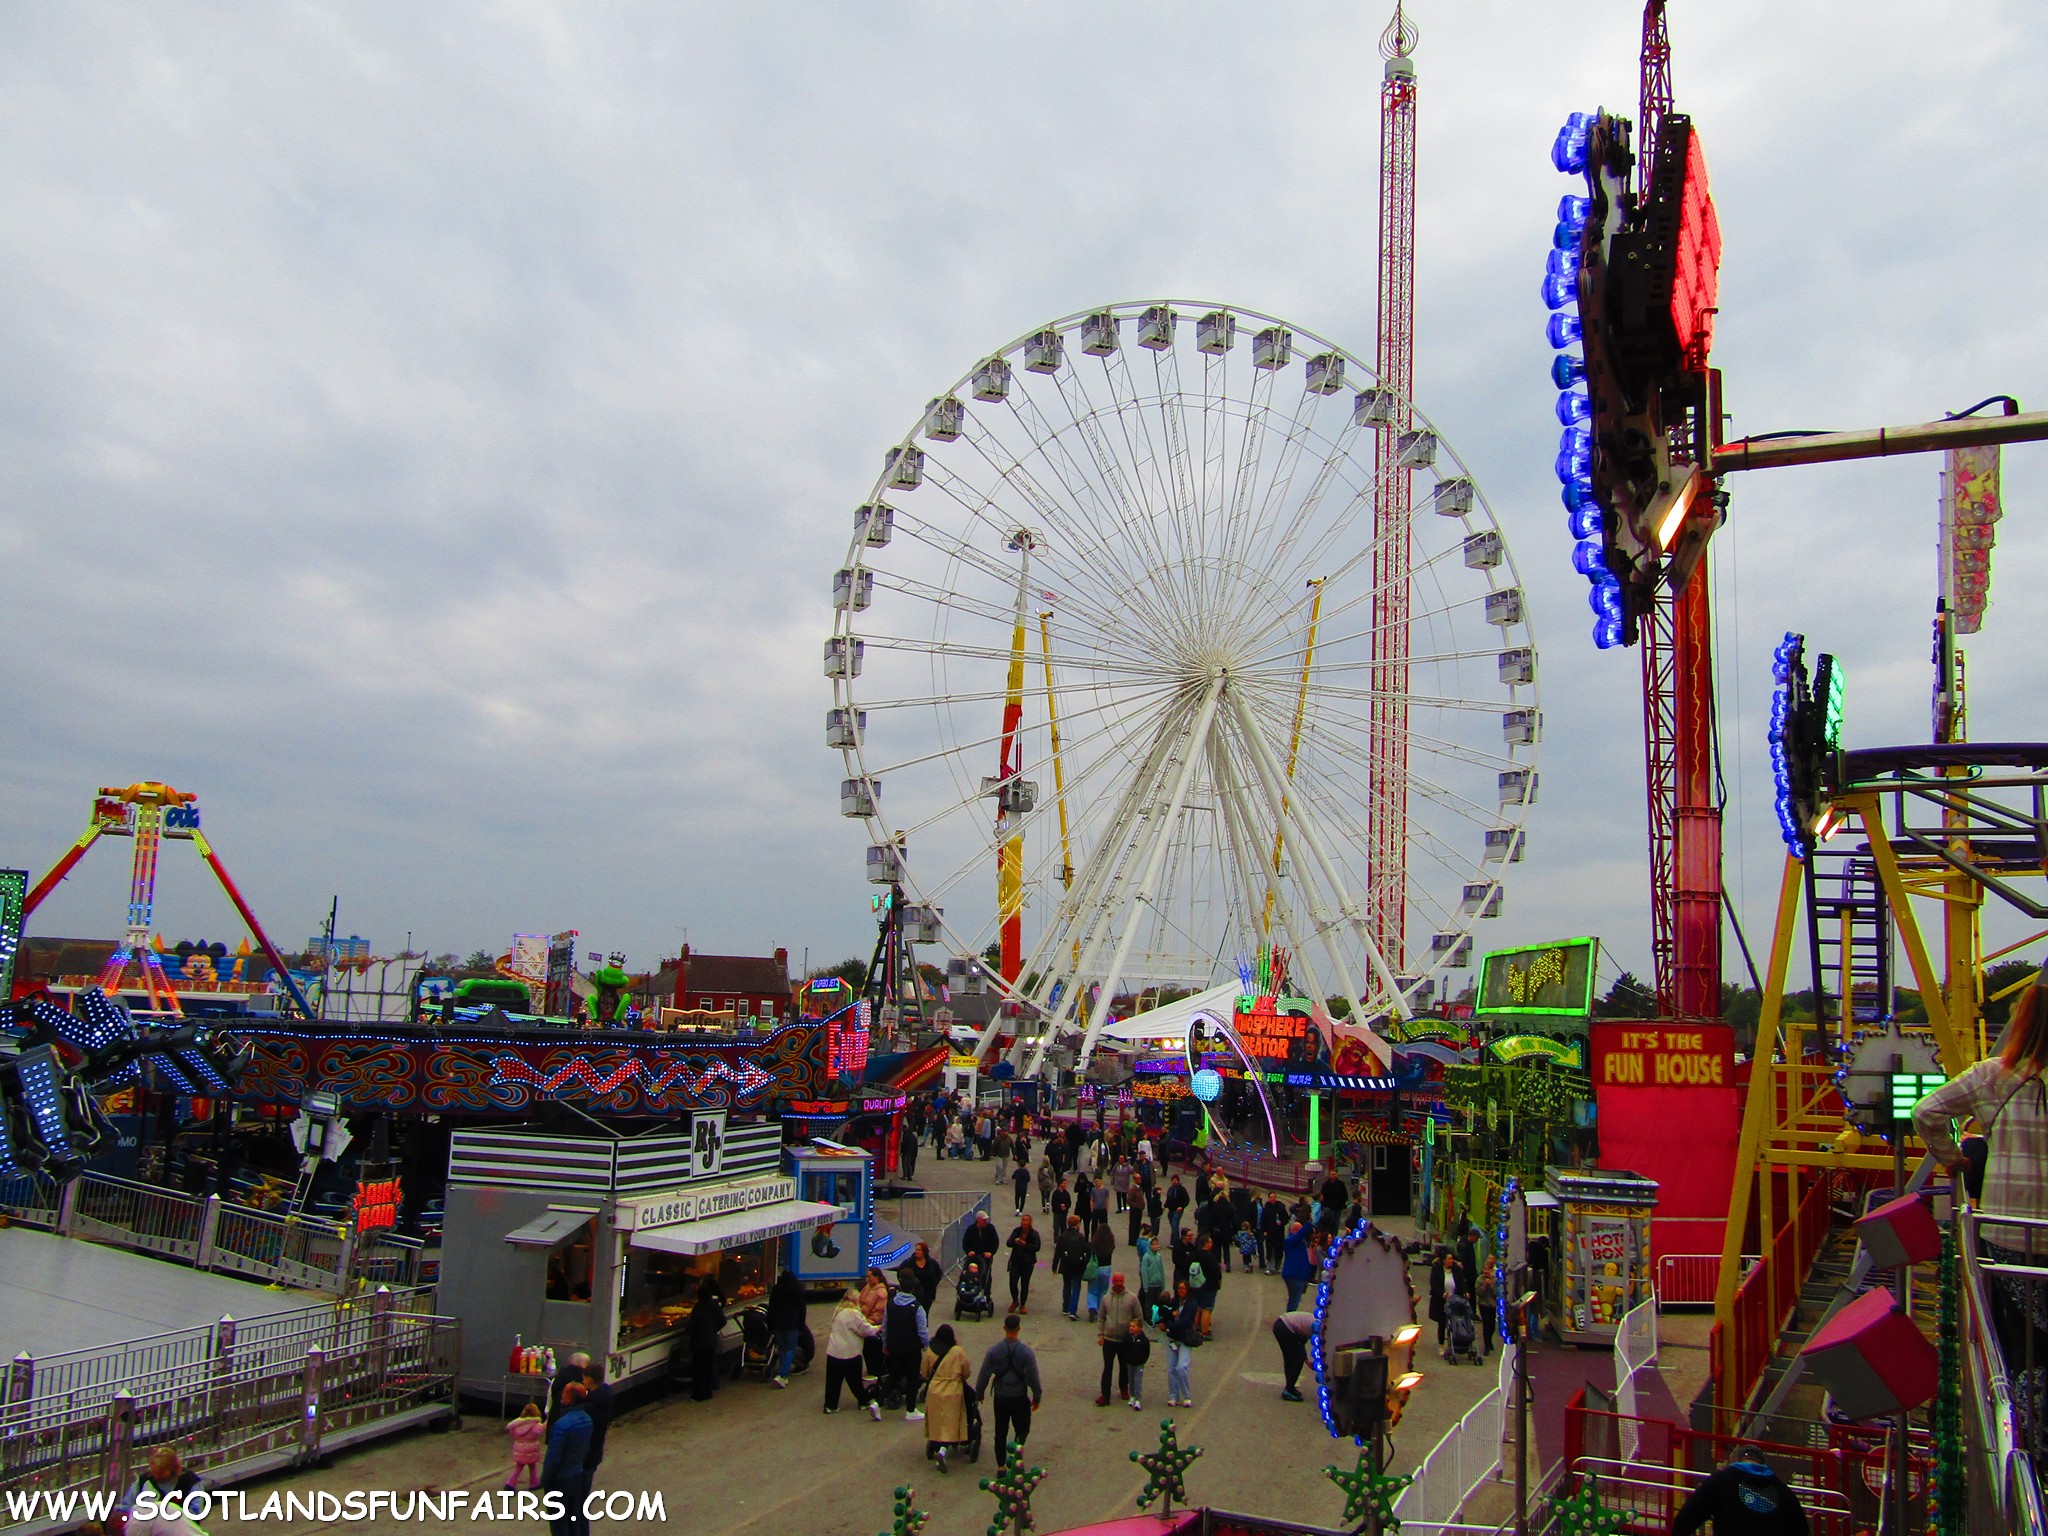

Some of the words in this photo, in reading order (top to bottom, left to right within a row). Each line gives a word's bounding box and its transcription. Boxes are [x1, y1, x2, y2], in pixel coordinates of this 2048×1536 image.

[1622, 1031, 1659, 1049] IT'S
[1664, 1032, 1703, 1050] THE
[1604, 1052, 1644, 1083] FUN
[1655, 1053, 1723, 1085] HOUSE
[357, 1203, 397, 1233] RAID
[641, 1201, 692, 1225] CLASSIC
[698, 1191, 745, 1214] CATERING
[748, 1182, 792, 1204] COMPANY
[718, 1238, 733, 1250] FOR
[735, 1235, 747, 1246] ALL
[749, 1231, 767, 1242] YOUR
[788, 1218, 816, 1232] CATERING
[816, 1213, 834, 1226] NEEDS
[1592, 1247, 1624, 1261] BOX
